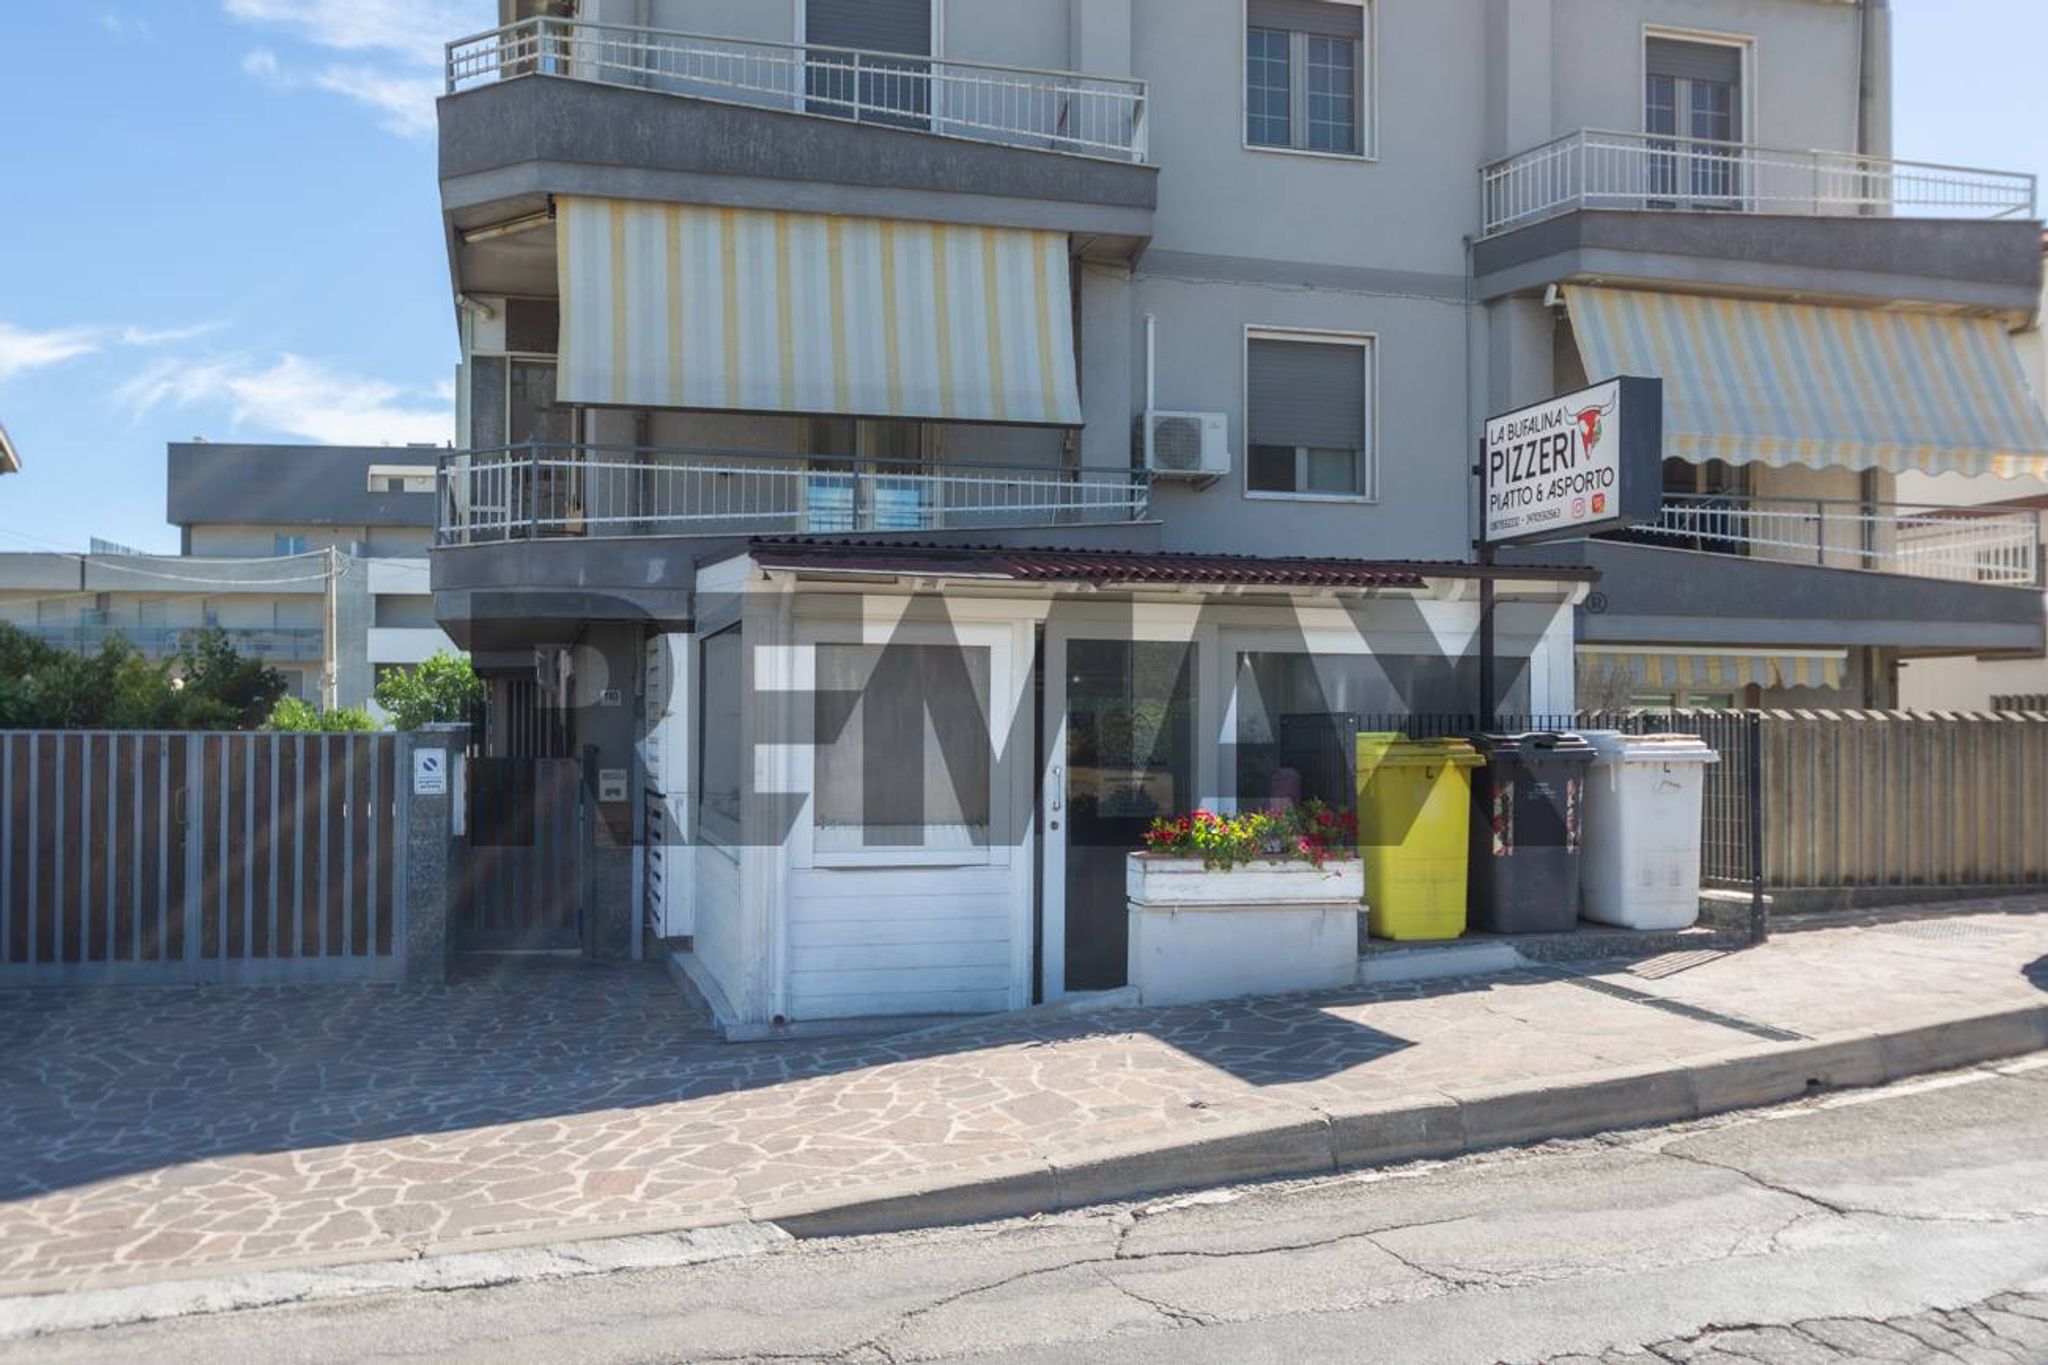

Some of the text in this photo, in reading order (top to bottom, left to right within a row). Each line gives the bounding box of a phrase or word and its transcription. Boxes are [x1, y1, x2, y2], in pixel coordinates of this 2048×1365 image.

[1491, 408, 1562, 445] LA BUFALINA
[1490, 466, 1615, 513] PIATTO & ASPORTO
